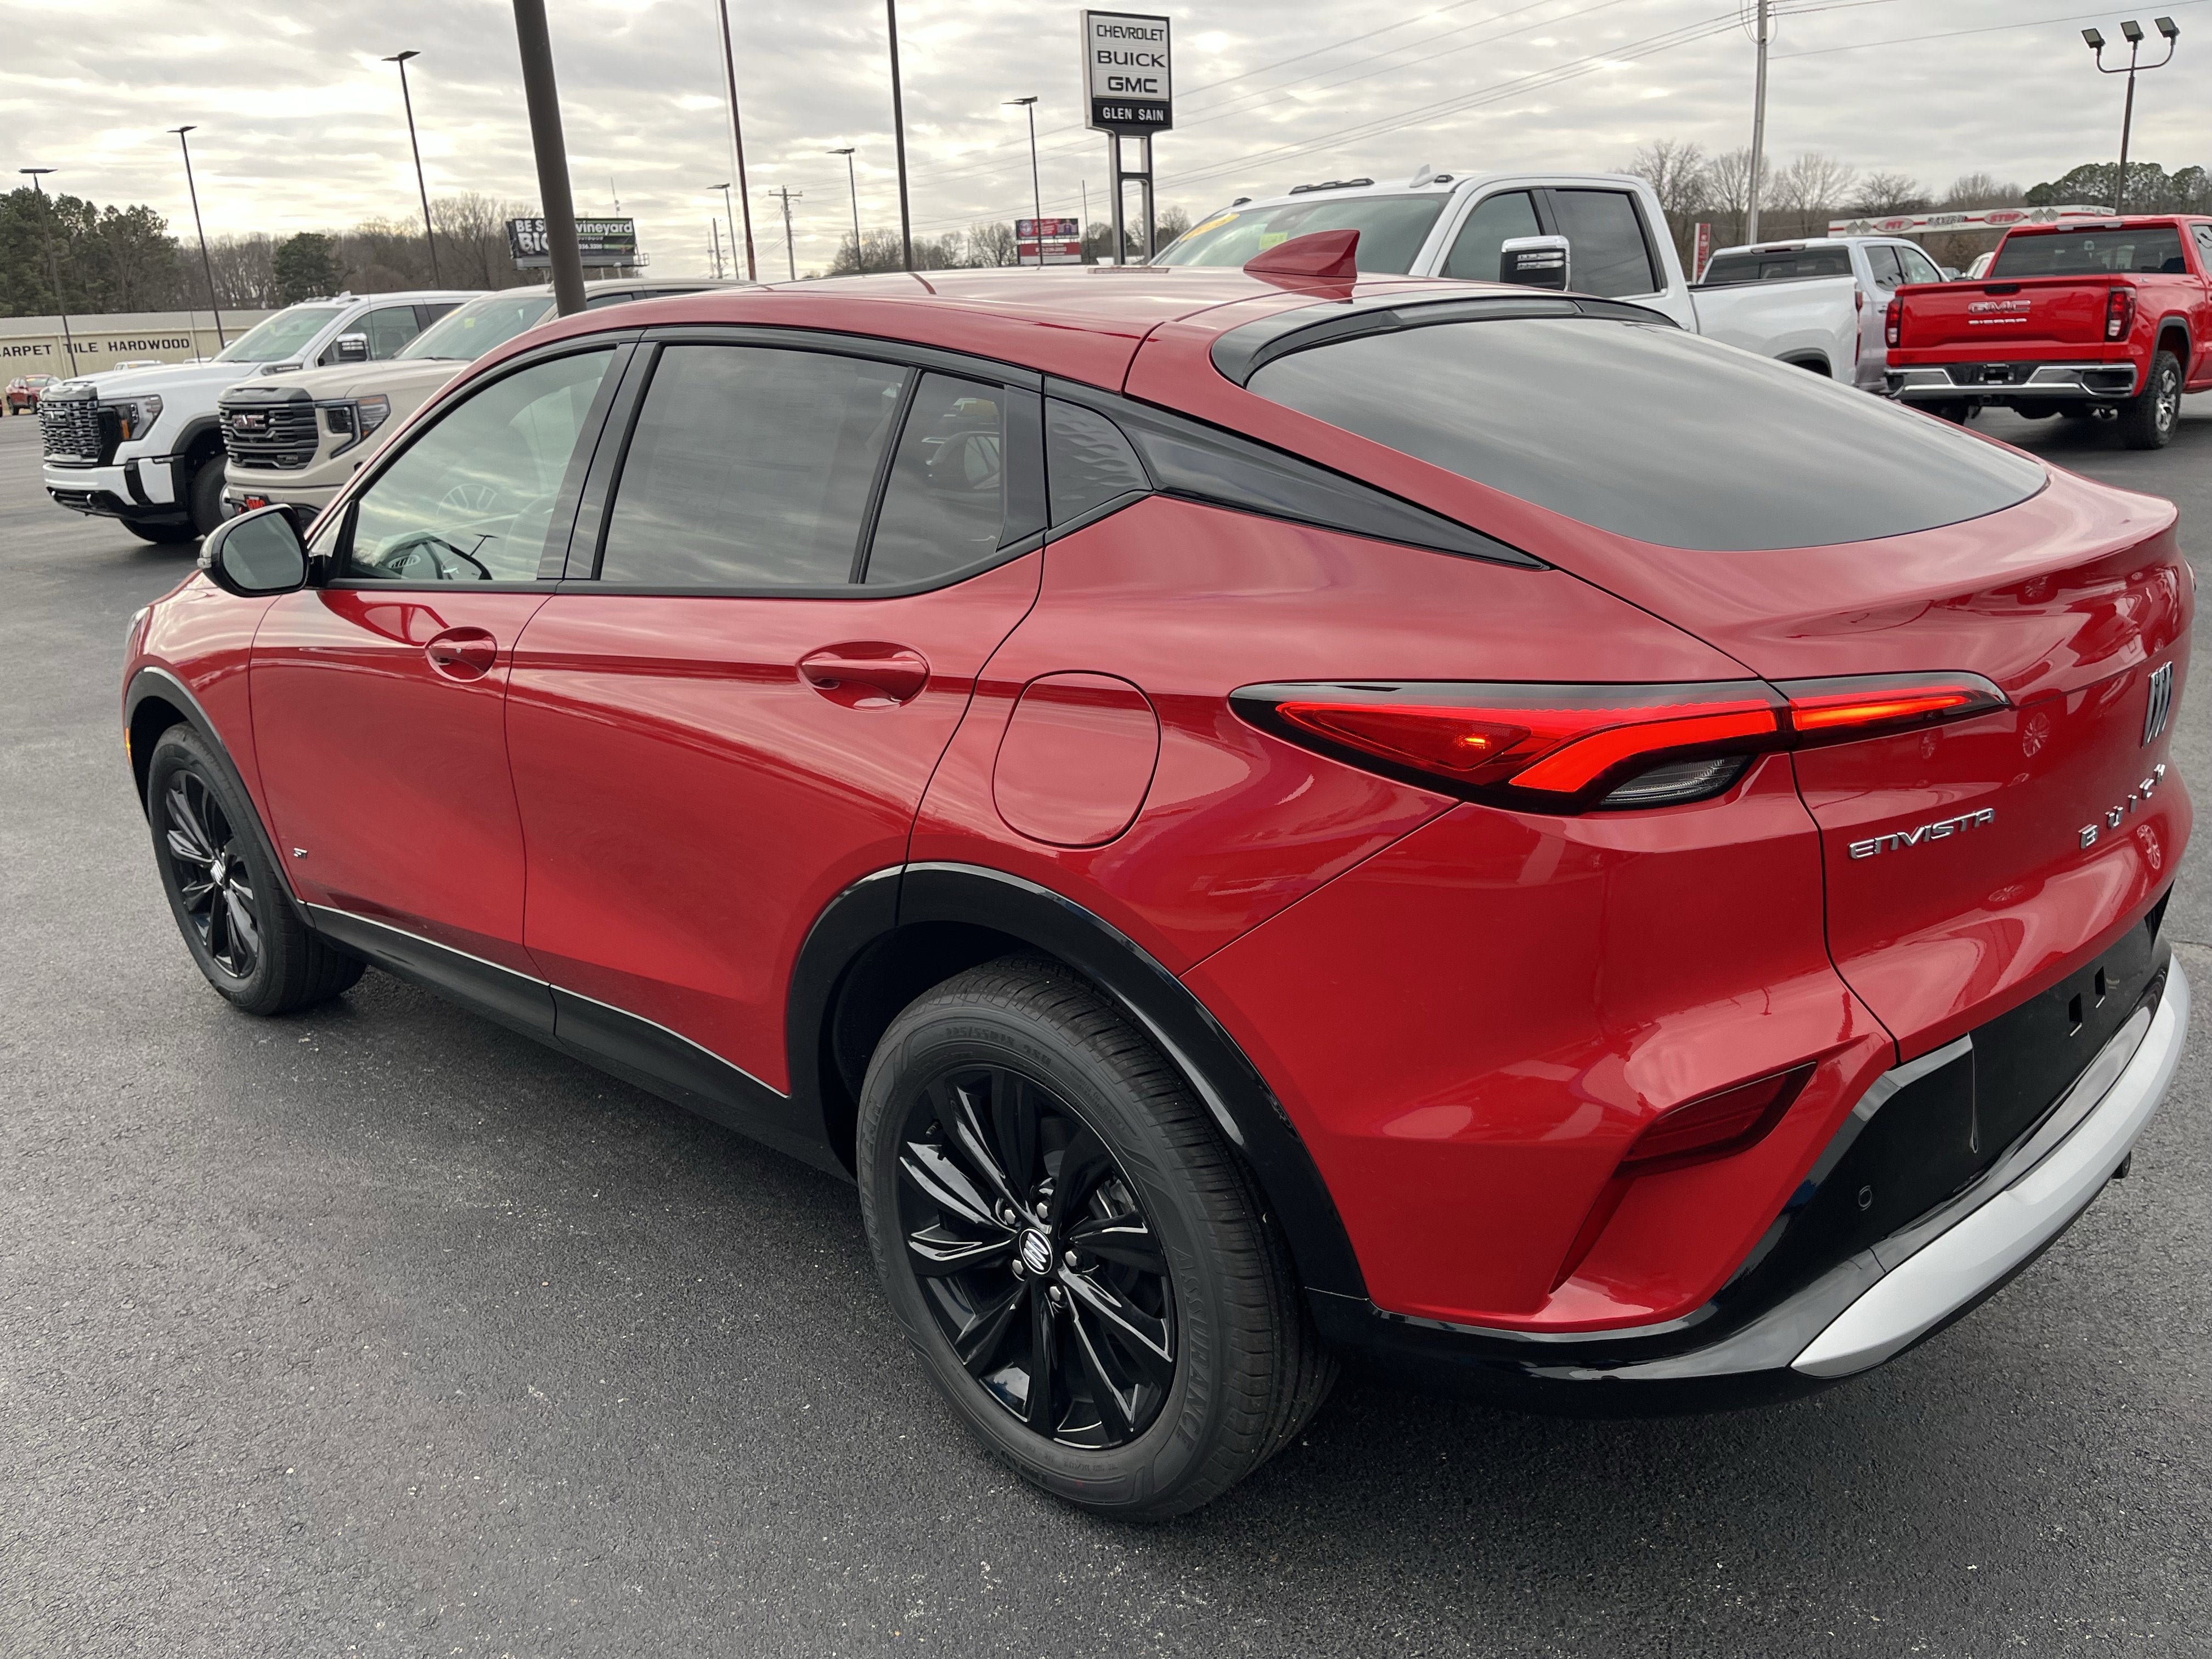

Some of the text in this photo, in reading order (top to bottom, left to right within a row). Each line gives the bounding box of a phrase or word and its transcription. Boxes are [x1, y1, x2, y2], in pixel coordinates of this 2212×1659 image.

[1097, 25, 1164, 41] CHEVROLET
[1097, 50, 1166, 67] BUICK
[1108, 76, 1158, 93] GMC
[1103, 107, 1164, 121] GLEN SAIN
[515, 219, 533, 233] BE
[575, 220, 633, 235] vineyard
[1968, 300, 2031, 315] GMC
[0, 338, 190, 357] ARPET TILE HARDWOOD
[2078, 764, 2166, 849] BUICK
[1848, 808, 1995, 859] ENVISTA
[1172, 1245, 1210, 1452] ASSURANCE
